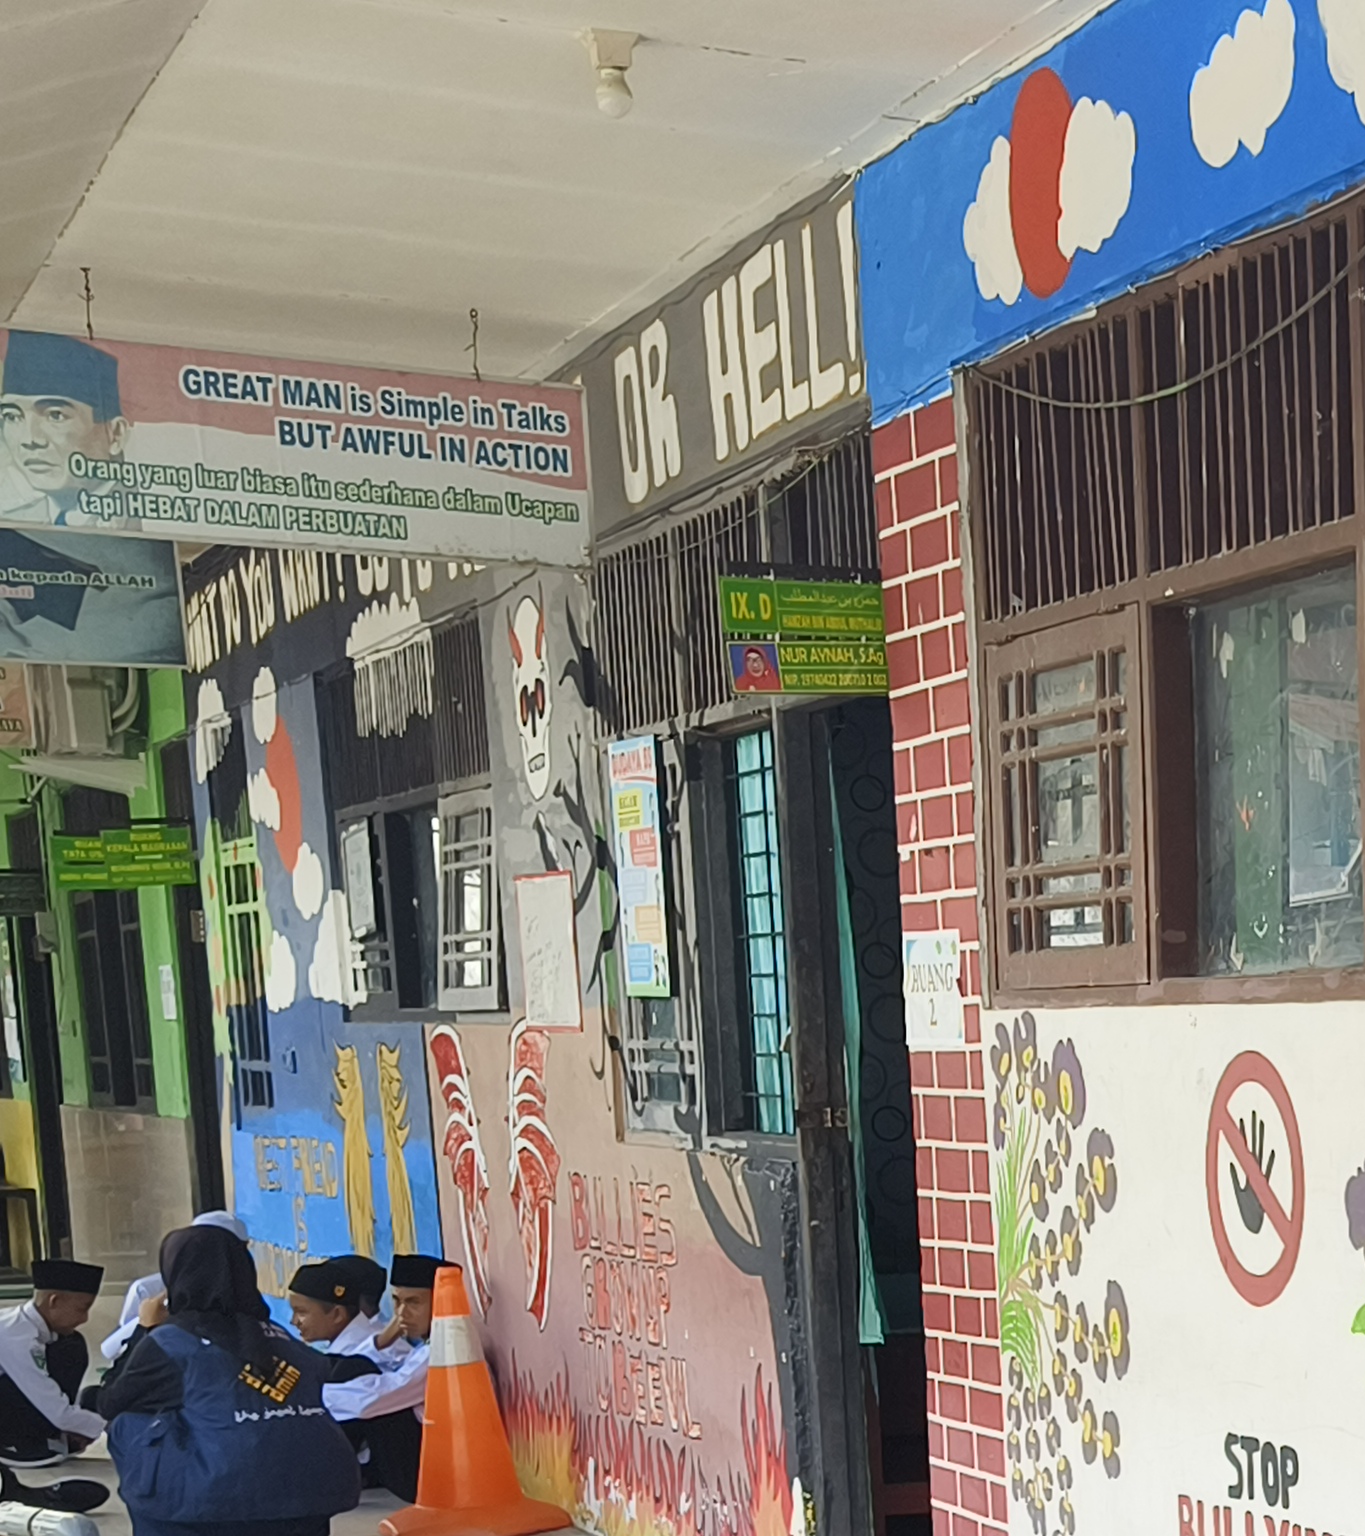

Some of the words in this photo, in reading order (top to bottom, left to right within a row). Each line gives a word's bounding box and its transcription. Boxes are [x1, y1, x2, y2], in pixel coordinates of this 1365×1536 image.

[702, 200, 868, 462] HELL!
[181, 368, 273, 403] GREAT
[281, 378, 342, 411] MAN
[350, 386, 373, 414] is
[380, 390, 465, 426] Simple
[471, 400, 495, 427] in
[501, 402, 567, 434] Talks
[278, 419, 332, 450] BUT
[340, 427, 433, 460] AWFUL
[439, 436, 466, 464] IN
[475, 440, 569, 474] ACTION
[68, 451, 137, 488] Orang
[138, 463, 192, 493] yang
[195, 463, 239, 491] luar
[241, 467, 300, 497] biasa
[301, 472, 332, 500] itu
[335, 478, 440, 510] sederhana
[443, 487, 503, 515] dalam
[505, 491, 580, 525] Ucapan
[78, 488, 122, 522] tapi
[126, 492, 201, 523] HEBAT
[203, 498, 280, 529] DALAM
[282, 505, 408, 540] PERBUATAN
[8, 567, 88, 585] kepada
[90, 572, 156, 589] ALLAH
[780, 646, 808, 663] NUR
[911, 963, 954, 993] RUANG
[928, 998, 938, 1026] 2
[1224, 1431, 1299, 1510] STOP
